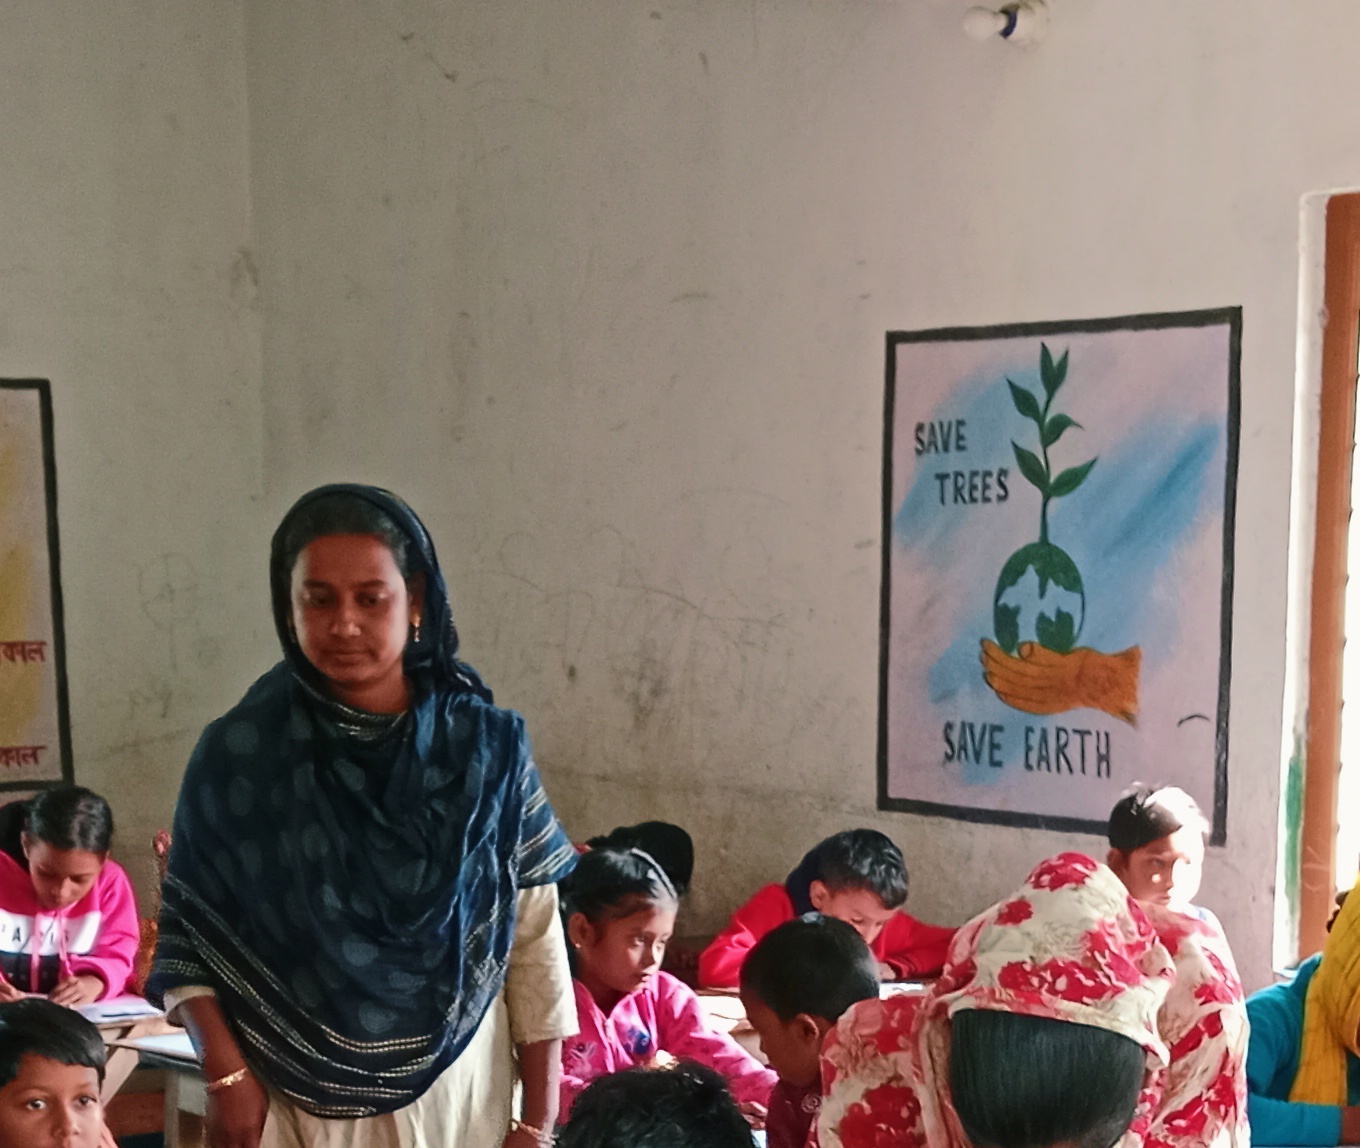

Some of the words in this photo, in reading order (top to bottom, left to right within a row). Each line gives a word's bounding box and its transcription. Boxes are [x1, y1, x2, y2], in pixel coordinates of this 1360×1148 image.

[914, 418, 968, 455] SAVE
[934, 468, 1010, 506] TREES
[942, 720, 1004, 768] SAVE
[1023, 724, 1112, 779] EARTH
